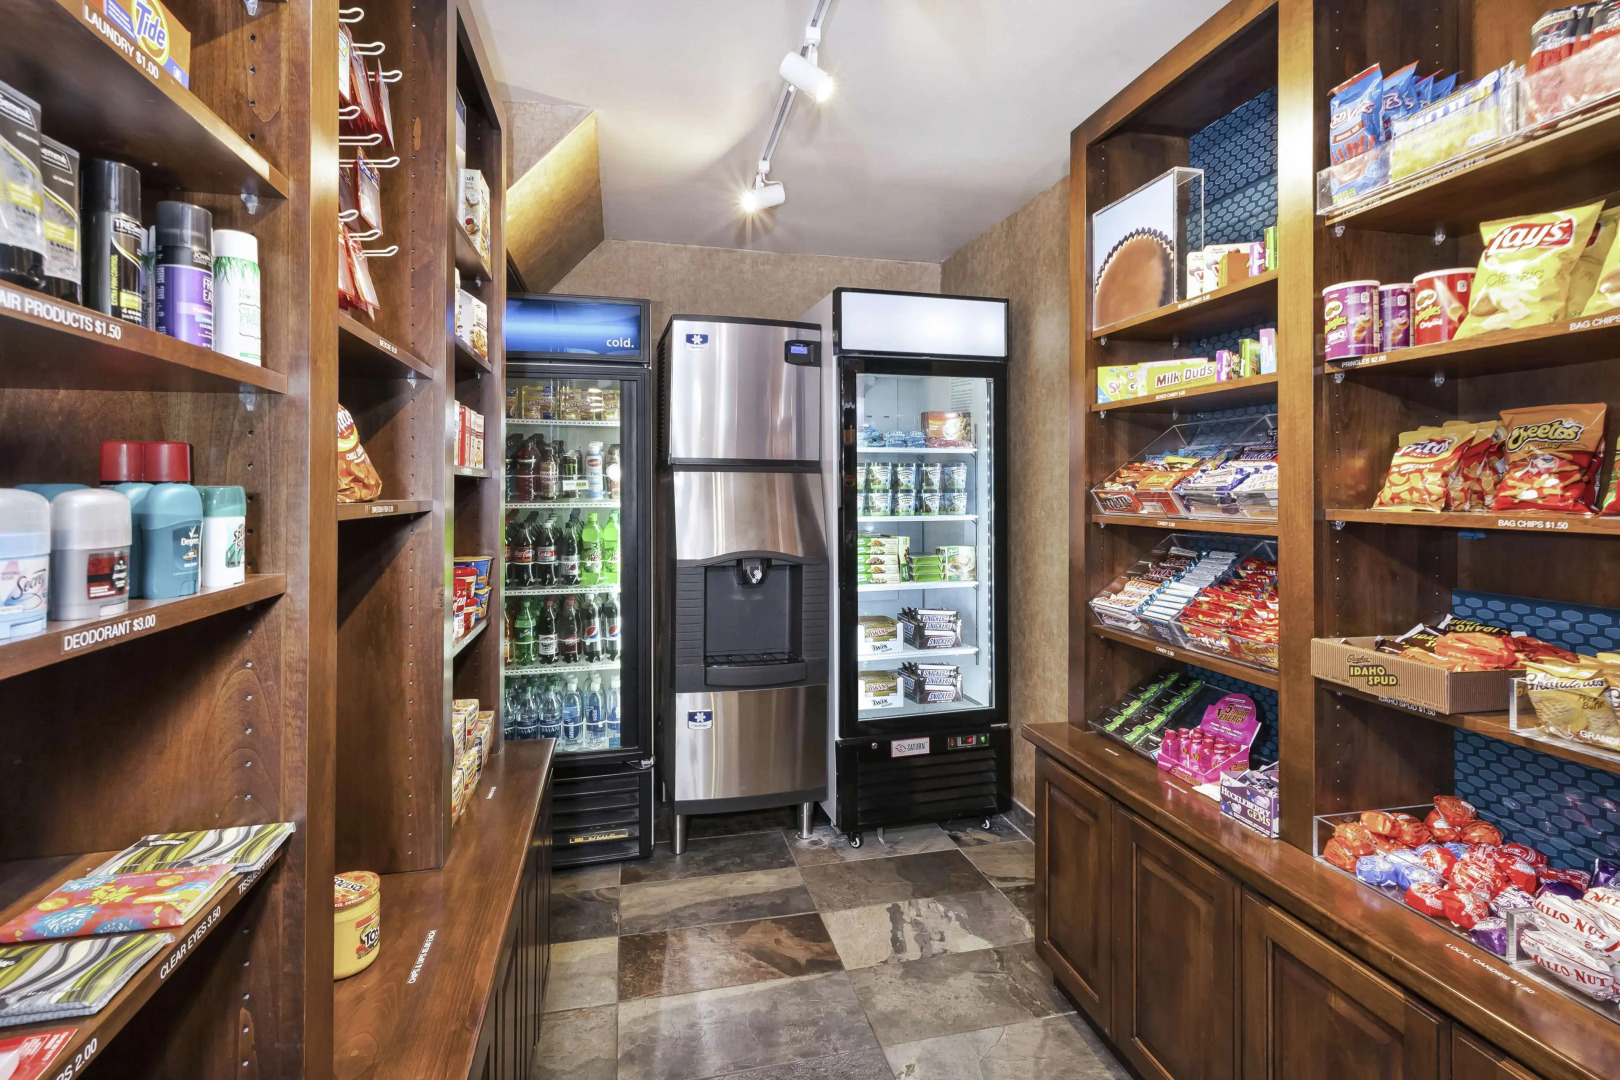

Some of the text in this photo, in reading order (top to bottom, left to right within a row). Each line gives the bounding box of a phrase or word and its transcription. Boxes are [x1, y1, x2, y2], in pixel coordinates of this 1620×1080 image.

[135, 0, 166, 49] Tide
[84, 5, 135, 58] LAUNDRY
[135, 51, 159, 79] $1.00
[24, 297, 93, 332] PRODUCTS
[94, 318, 122, 340] $1.50
[1420, 318, 1443, 329] Original
[1569, 314, 1620, 331] BAG CHIPS
[606, 336, 635, 348] cold.
[1341, 357, 1370, 368] PRINGLES
[1155, 364, 1214, 388] Milk Duds
[1498, 519, 1568, 530] BAG CHIPS $1.50
[64, 614, 156, 651] DEODORANT $3.00
[1350, 666, 1385, 676] IDAHO
[1367, 676, 1397, 686] SPUD
[1379, 695, 1436, 716] IDAHO SPUD $1.50
[1219, 713, 1246, 724] ENERGY
[907, 742, 926, 752] SATURN
[1221, 786, 1271, 818] HUCKLEBERRY
[1247, 808, 1271, 827] GEMS
[160, 905, 221, 979] CLEAR EYES 3.50
[1445, 943, 1471, 960] LOCAL
[1473, 958, 1511, 981] CANDIES
[75, 1038, 98, 1072] 2.00
